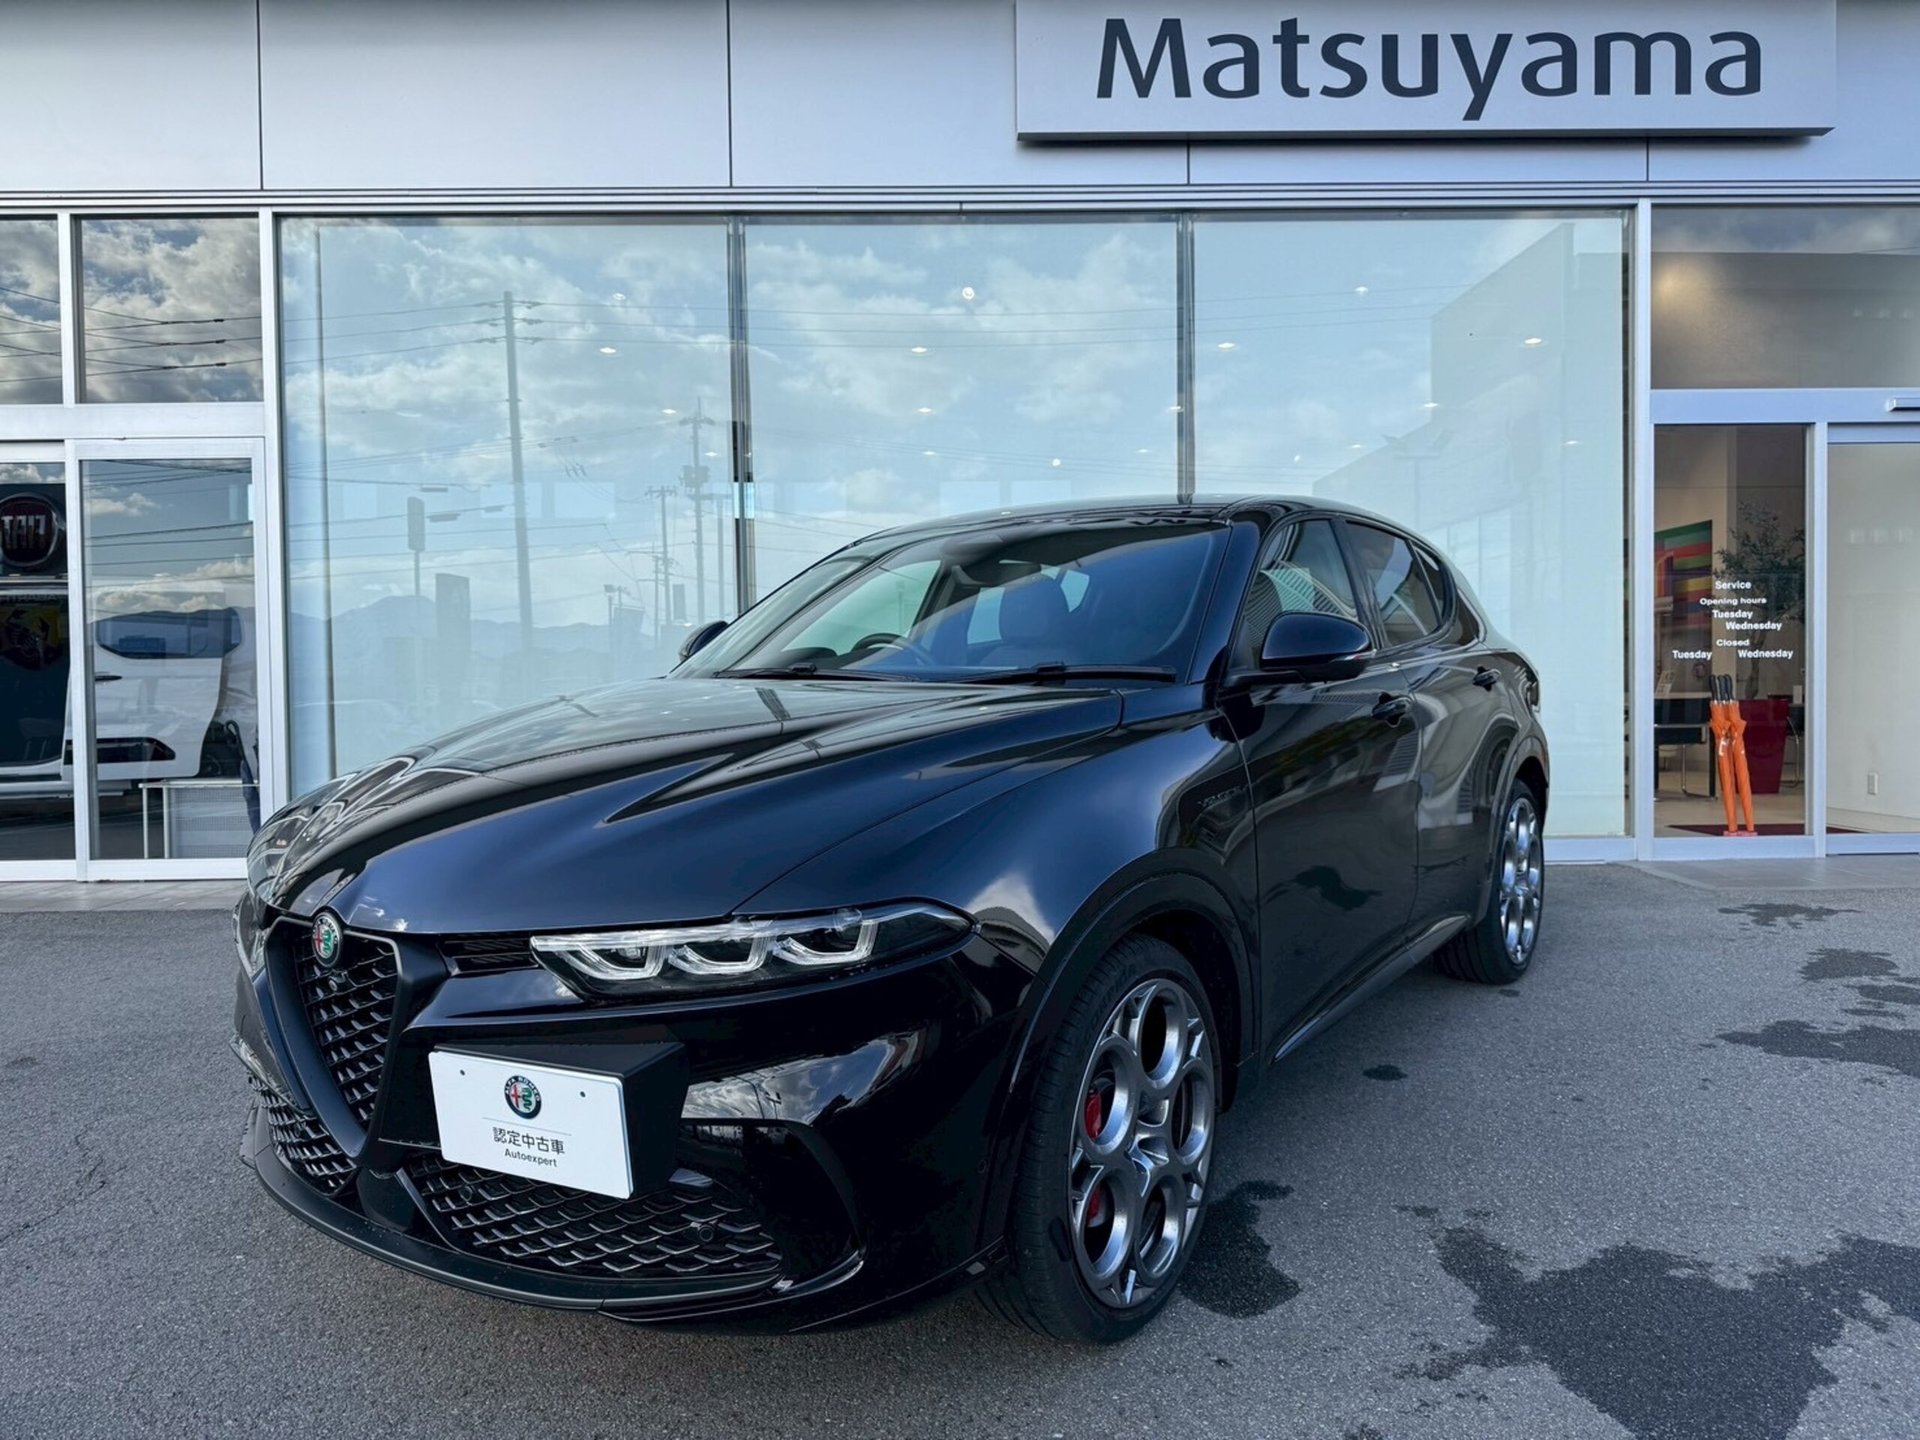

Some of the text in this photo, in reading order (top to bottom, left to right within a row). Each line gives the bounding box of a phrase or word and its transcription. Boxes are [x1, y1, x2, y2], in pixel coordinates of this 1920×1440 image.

[1096, 17, 1763, 121] Matsuyama
[1715, 580, 1752, 590] Service
[1699, 597, 1738, 606] Opening
[1712, 609, 1753, 620] Tuesday
[1725, 621, 1782, 631] Wednesday
[1716, 638, 1750, 647] Closed
[1672, 650, 1793, 660] Tuesday Wednesday
[493, 1126, 566, 1155] 認定中古車
[504, 1148, 558, 1168] Autoexpert
